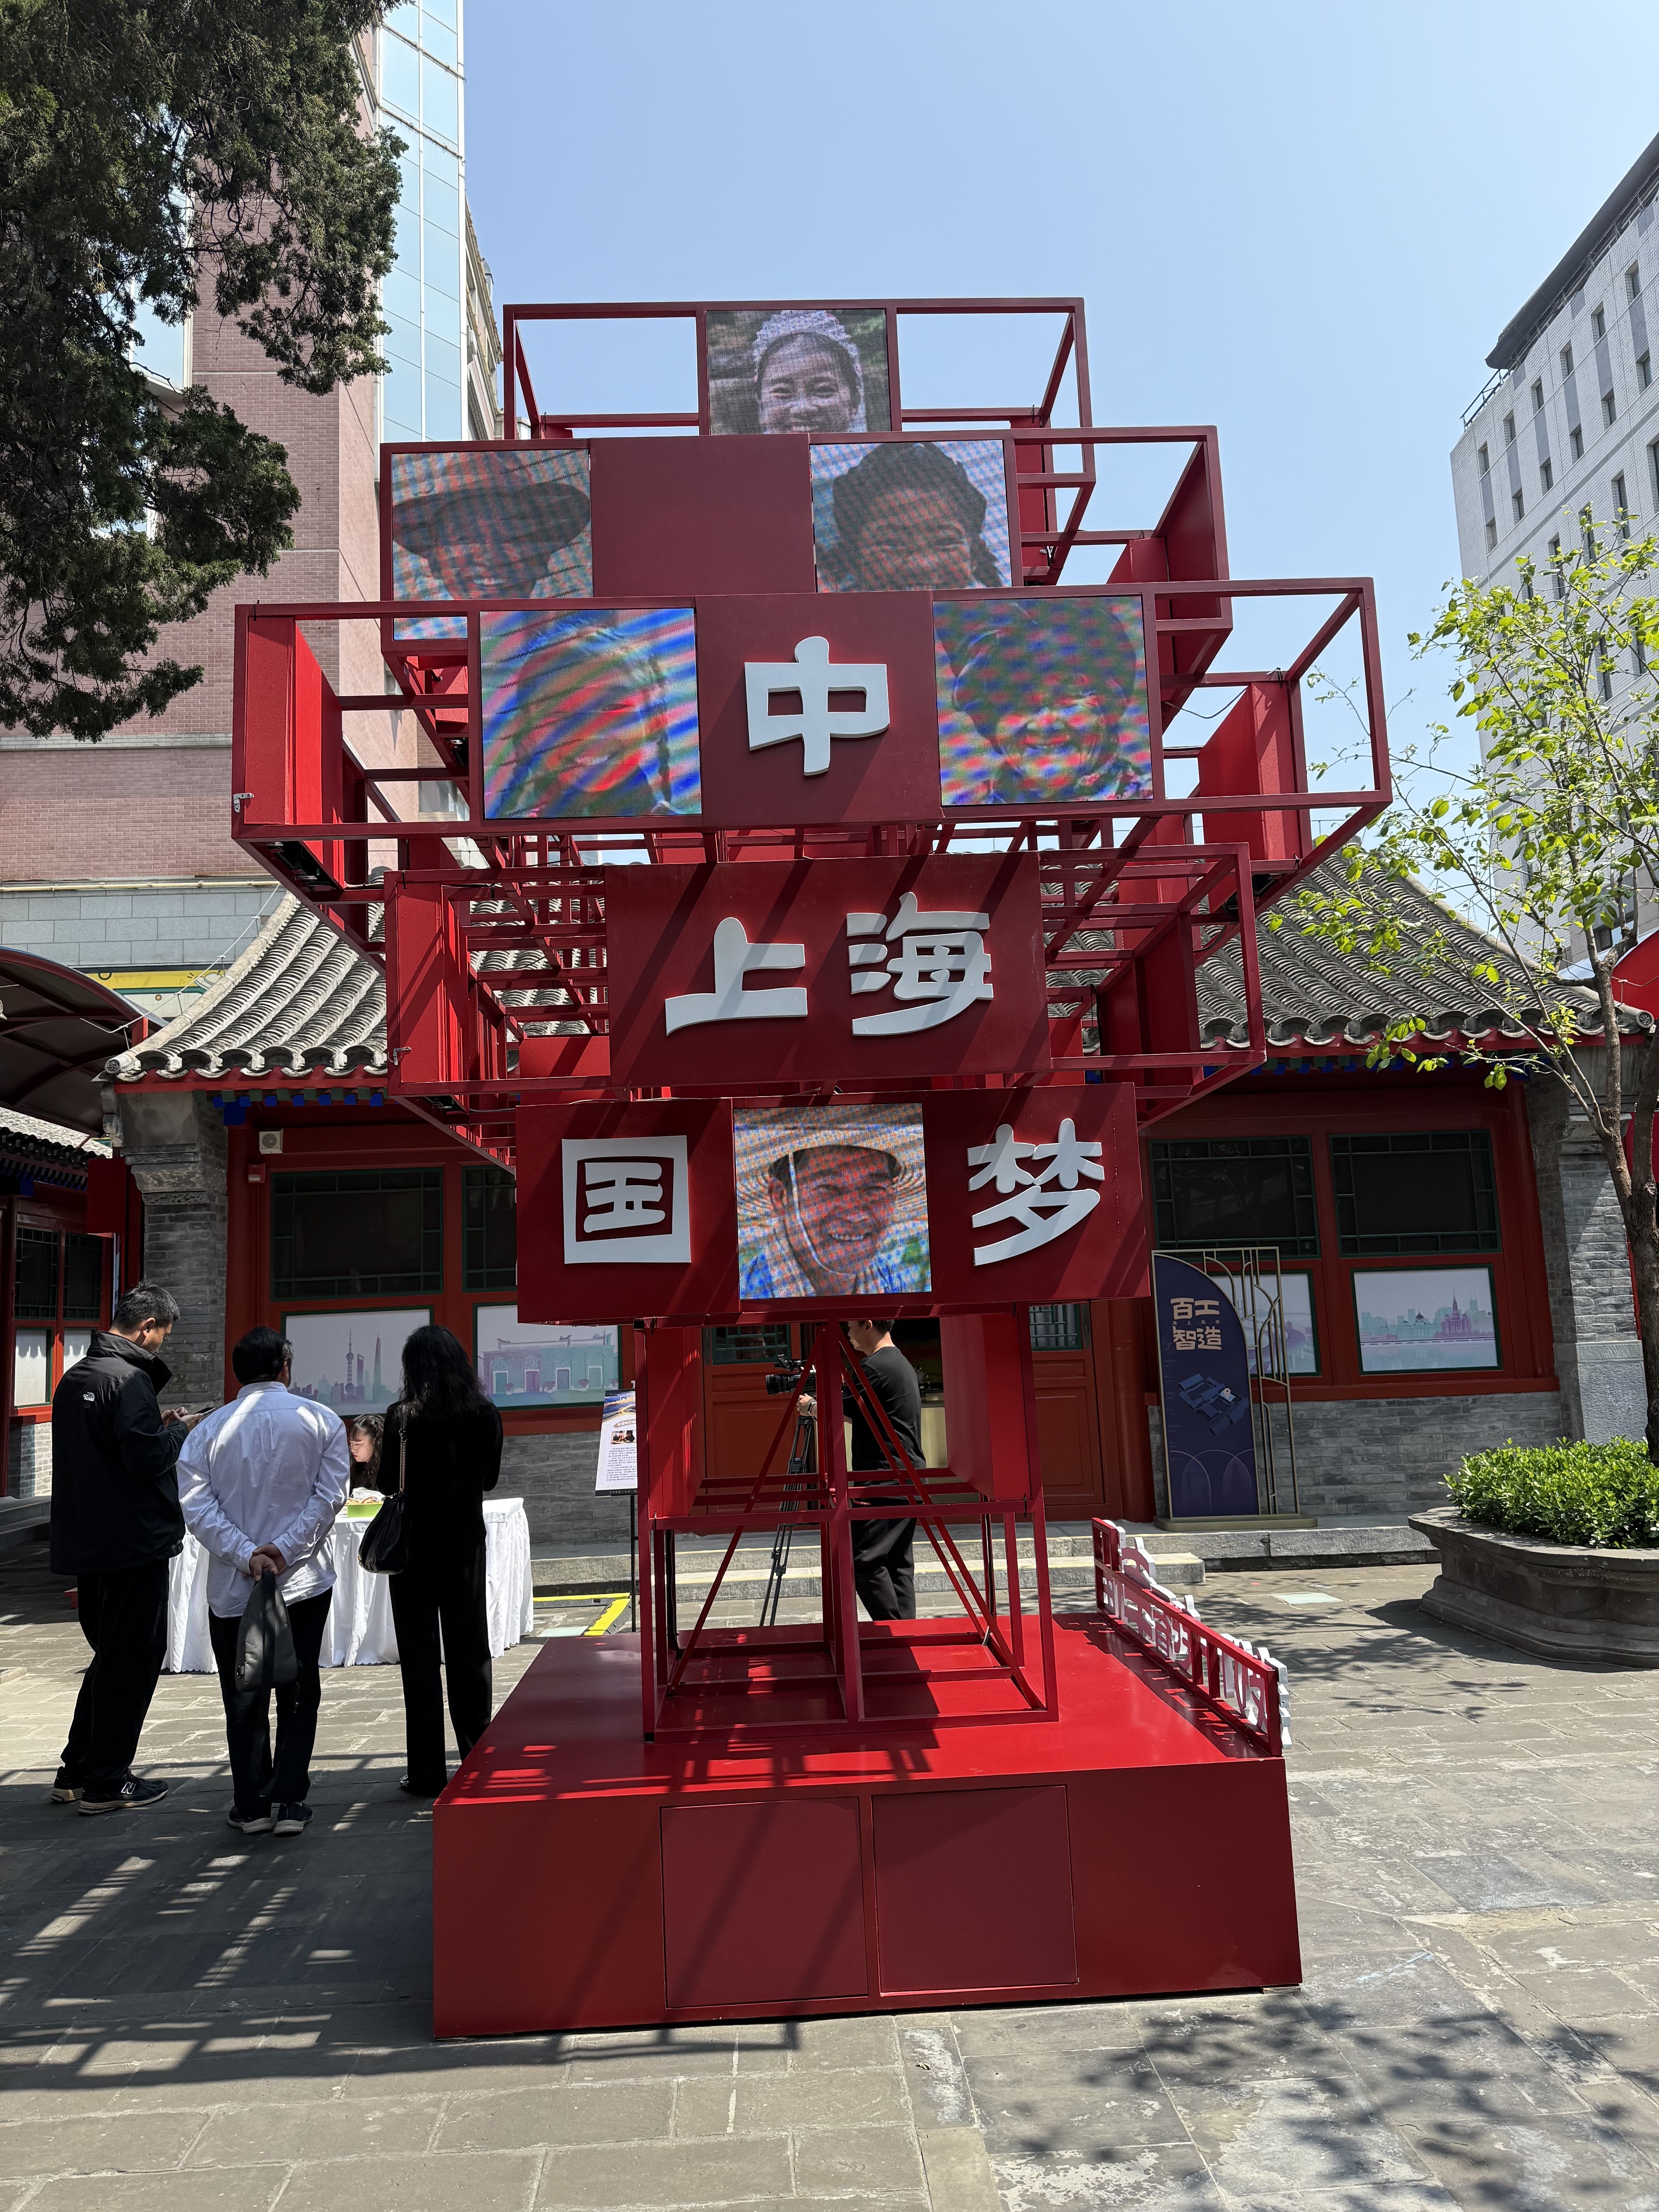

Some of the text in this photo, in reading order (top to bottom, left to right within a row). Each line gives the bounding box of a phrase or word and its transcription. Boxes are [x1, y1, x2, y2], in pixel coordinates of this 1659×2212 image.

[744, 636, 890, 776] 中
[665, 892, 994, 1036] 上海
[562, 1118, 1105, 1266] 国 梦
[1171, 1297, 1220, 1320] 百工
[1172, 1326, 1222, 1350] 智造
[121, 1782, 136, 1794] N
